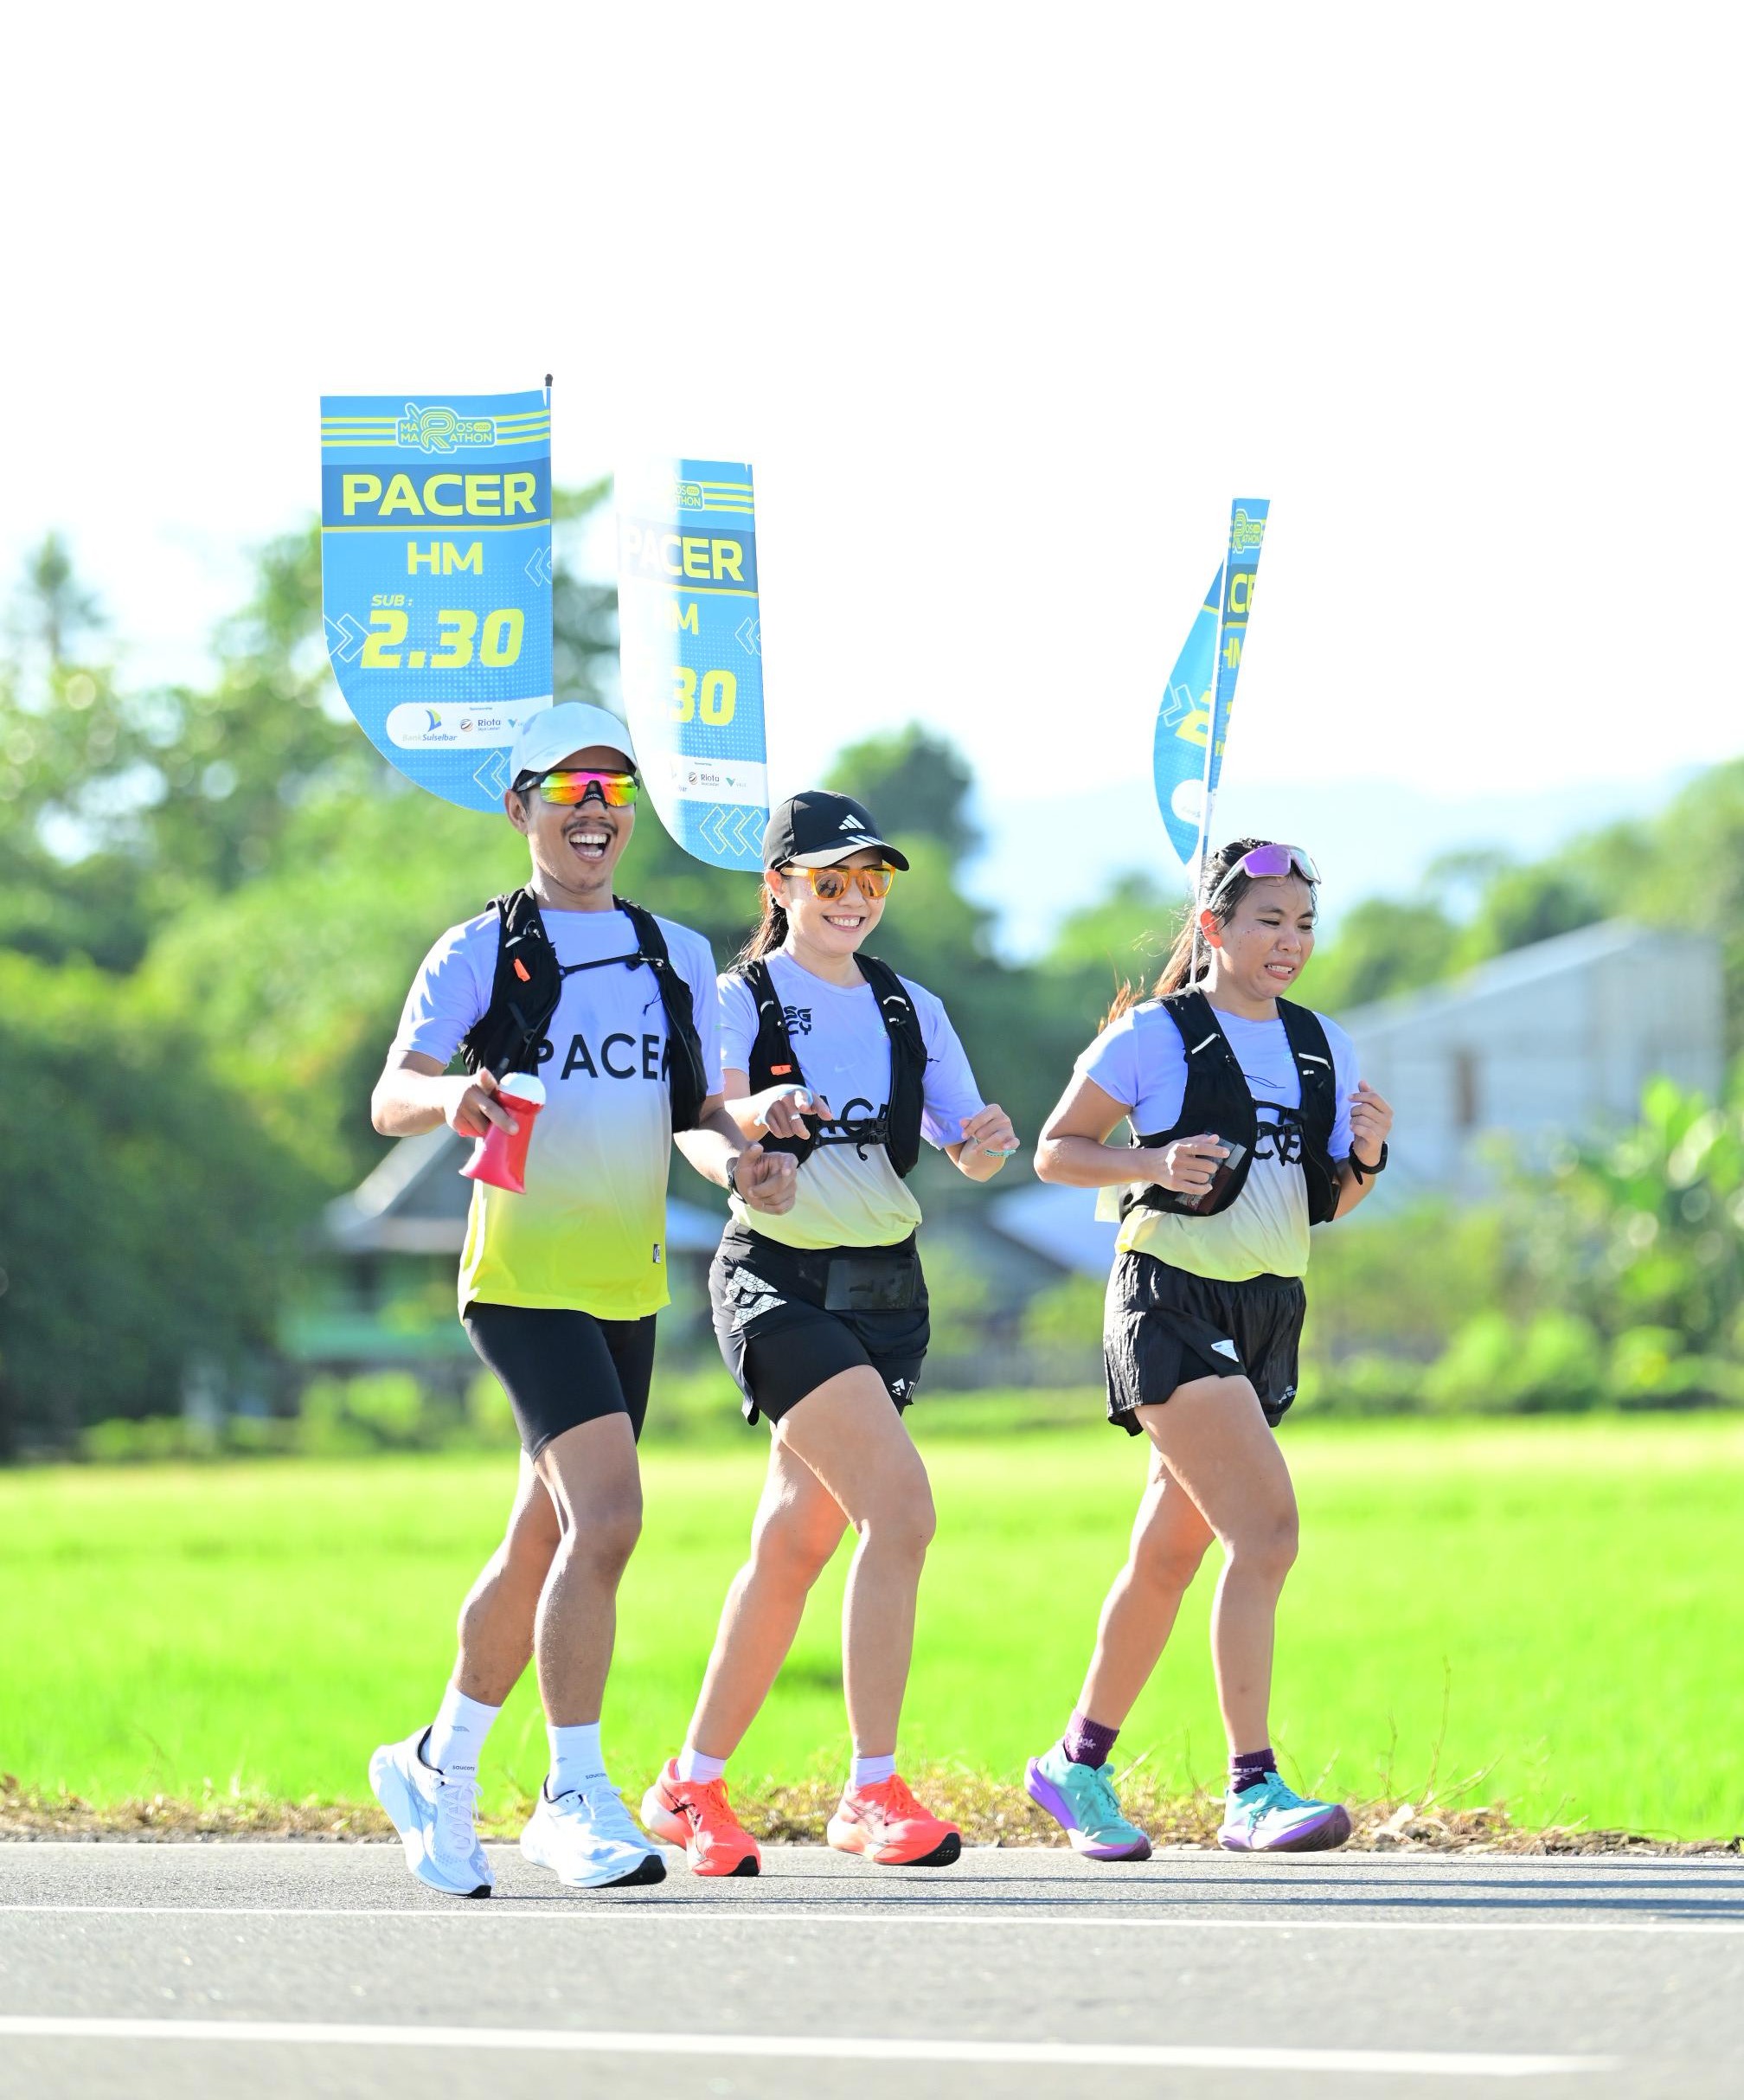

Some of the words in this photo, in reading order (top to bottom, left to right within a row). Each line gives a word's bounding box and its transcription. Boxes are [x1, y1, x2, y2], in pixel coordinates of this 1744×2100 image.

[343, 472, 537, 517] PACER
[407, 542, 484, 575] HM
[360, 608, 525, 669] 2.30
